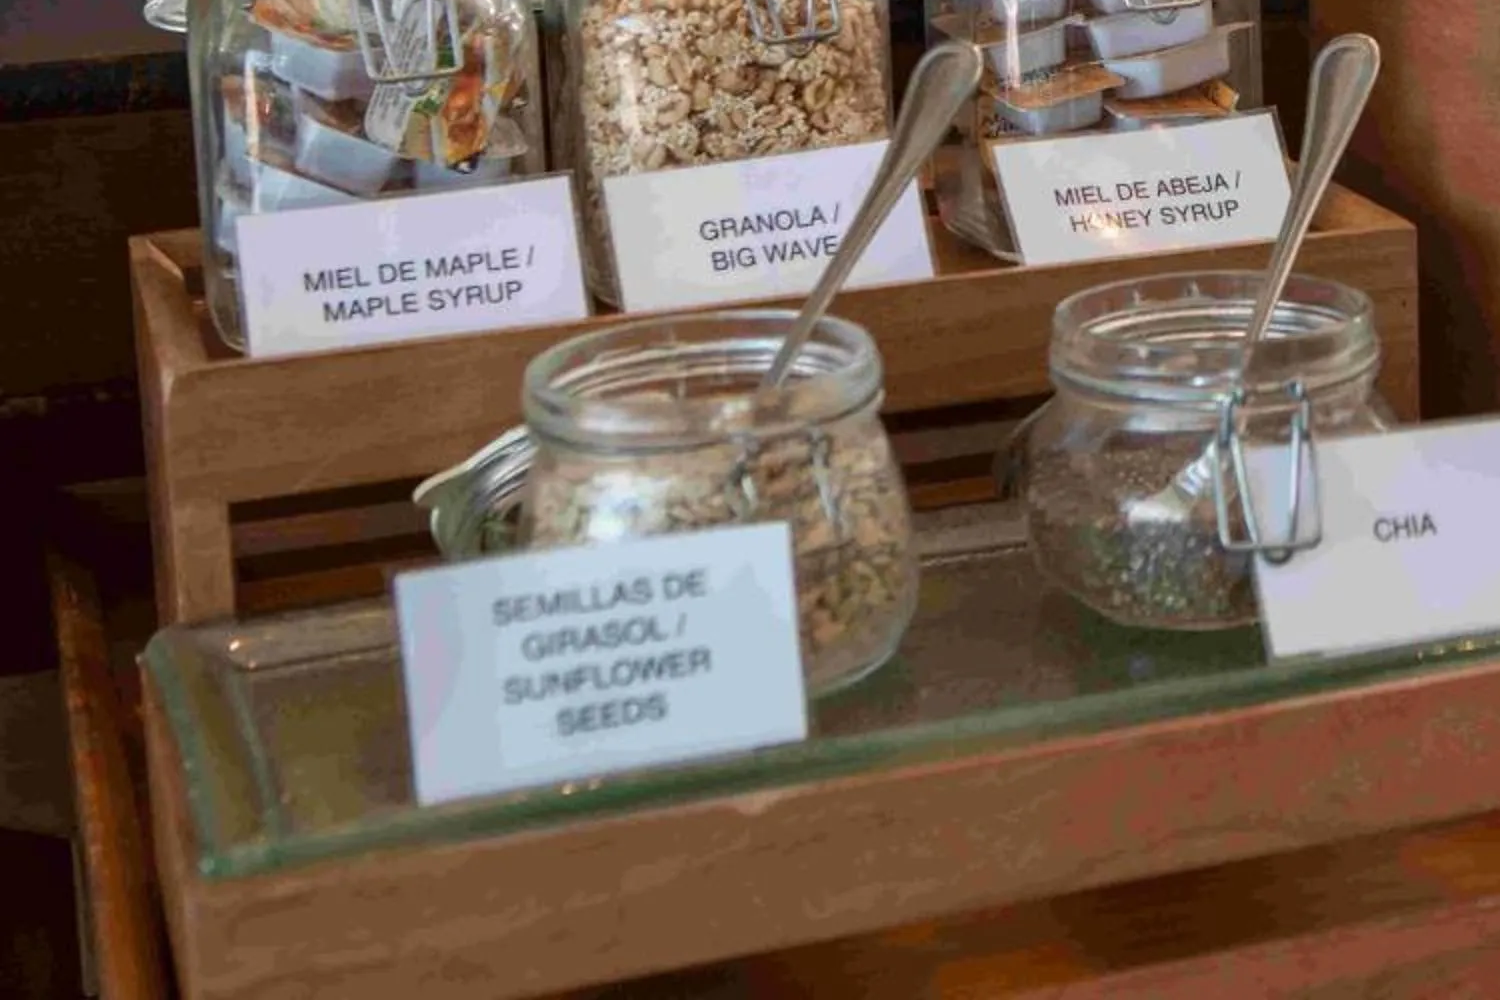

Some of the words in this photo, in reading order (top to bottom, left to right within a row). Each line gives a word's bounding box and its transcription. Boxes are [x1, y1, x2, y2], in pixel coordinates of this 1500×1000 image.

[1054, 185, 1111, 206] MIEL
[1116, 181, 1149, 201] DE
[1156, 172, 1228, 198] ABEJA
[700, 205, 828, 241] GRANOLA
[1160, 199, 1239, 226] SYRUP
[303, 267, 371, 293] MIEL
[377, 261, 417, 285] DE
[425, 247, 519, 279] MAPLE
[712, 247, 757, 271] BIG
[762, 235, 839, 264] WAVE
[324, 291, 420, 323] MAPLE
[427, 280, 523, 311] SYRUP
[1373, 512, 1438, 543] CHIA
[491, 575, 653, 628] SEMILLAS
[662, 569, 708, 600] DE
[520, 617, 669, 663] GIRASOL
[503, 647, 714, 705] SUNFLOWER
[556, 693, 667, 735] SEEDS
